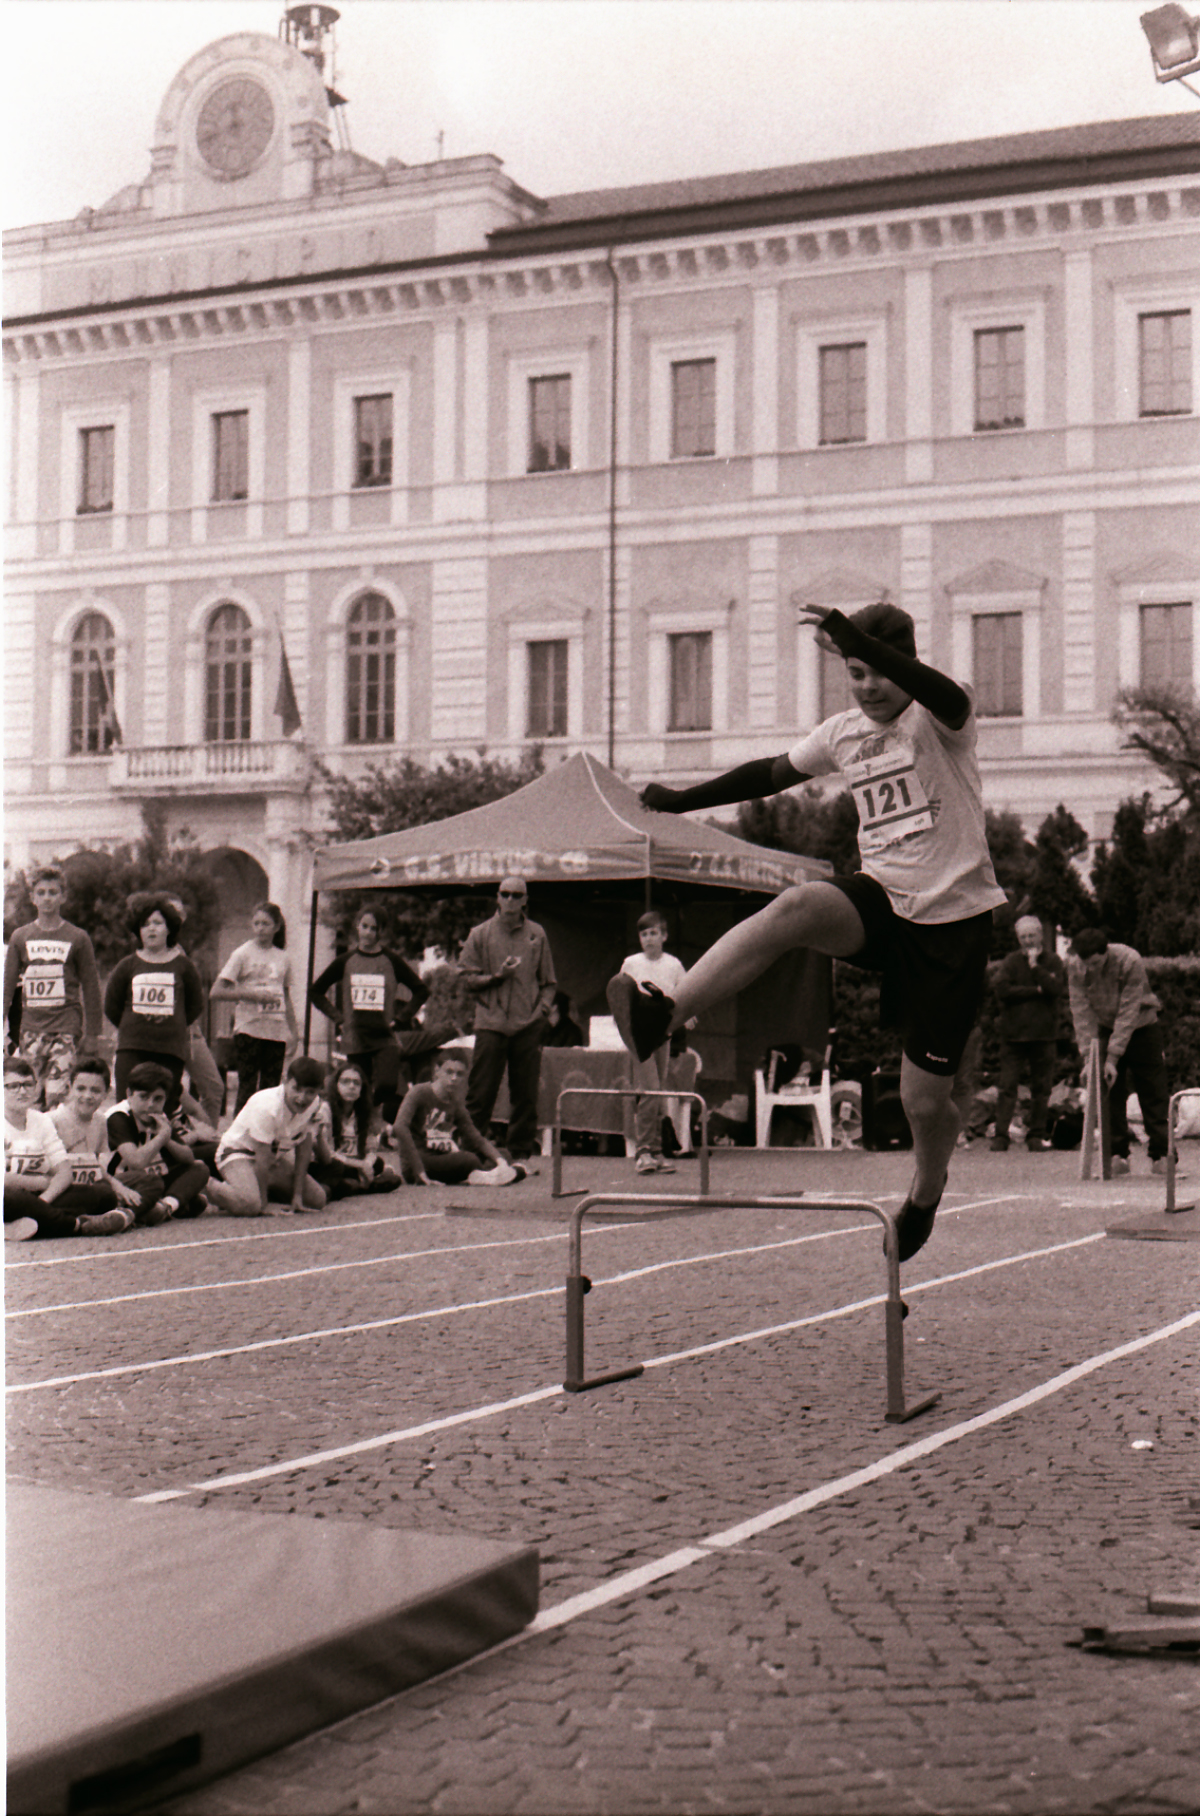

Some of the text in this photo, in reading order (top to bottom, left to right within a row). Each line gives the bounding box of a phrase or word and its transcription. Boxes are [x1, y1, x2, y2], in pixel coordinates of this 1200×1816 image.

[862, 777, 912, 818] 121
[30, 981, 56, 996] 107
[139, 987, 166, 1003] 106
[354, 989, 377, 1001] 114
[72, 1170, 96, 1184] 108
